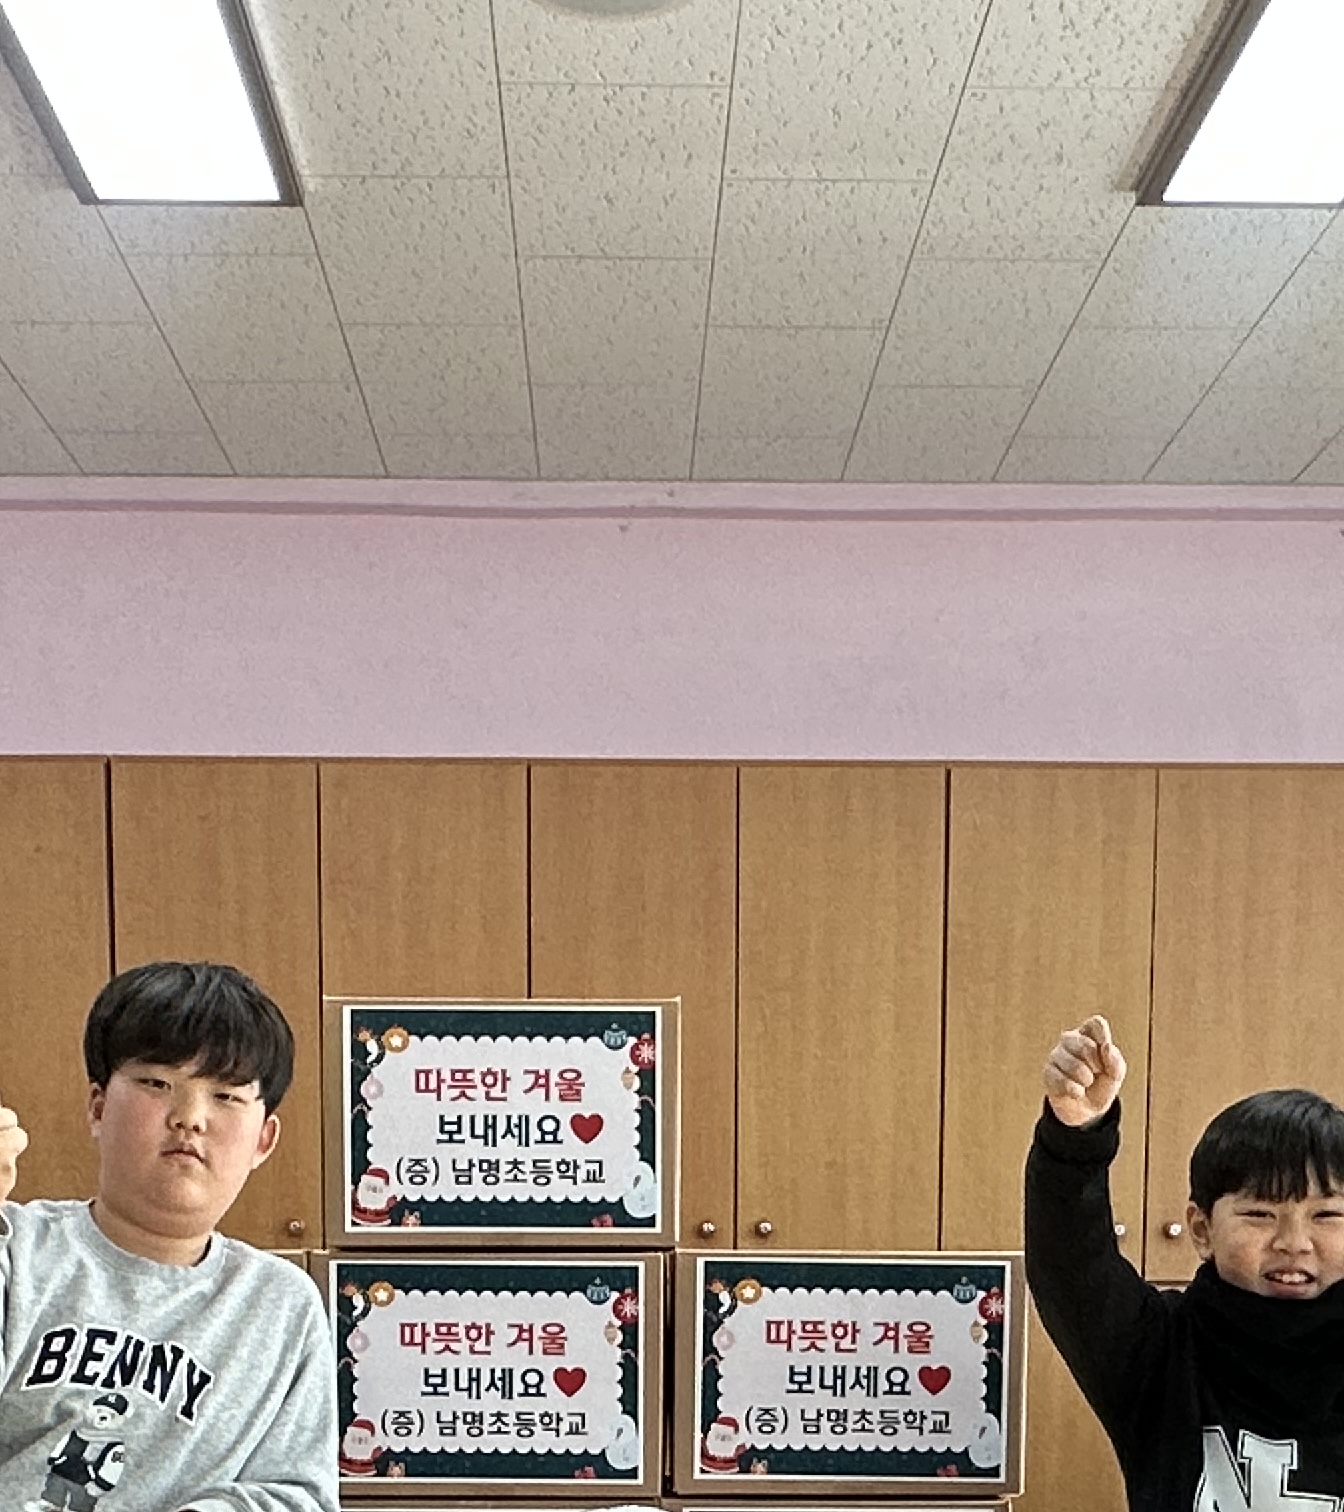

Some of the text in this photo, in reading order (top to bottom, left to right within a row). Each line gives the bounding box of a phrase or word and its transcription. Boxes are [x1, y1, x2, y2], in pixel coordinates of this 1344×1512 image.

[414, 1067, 586, 1102] 따뜻한 겨울
[436, 1114, 564, 1148] 보내세요
[395, 1156, 606, 1186] (증) 남명초등학교
[398, 1321, 568, 1356] 따뜻한 겨울
[765, 1319, 935, 1355] 따뜻한 겨울
[22, 1324, 213, 1425] BENNY
[420, 1366, 548, 1400] 보내세요
[785, 1365, 912, 1398] 보내세요
[380, 1408, 589, 1438] (증) 남명초등학교
[744, 1405, 952, 1436] (증) 남명초등학교
